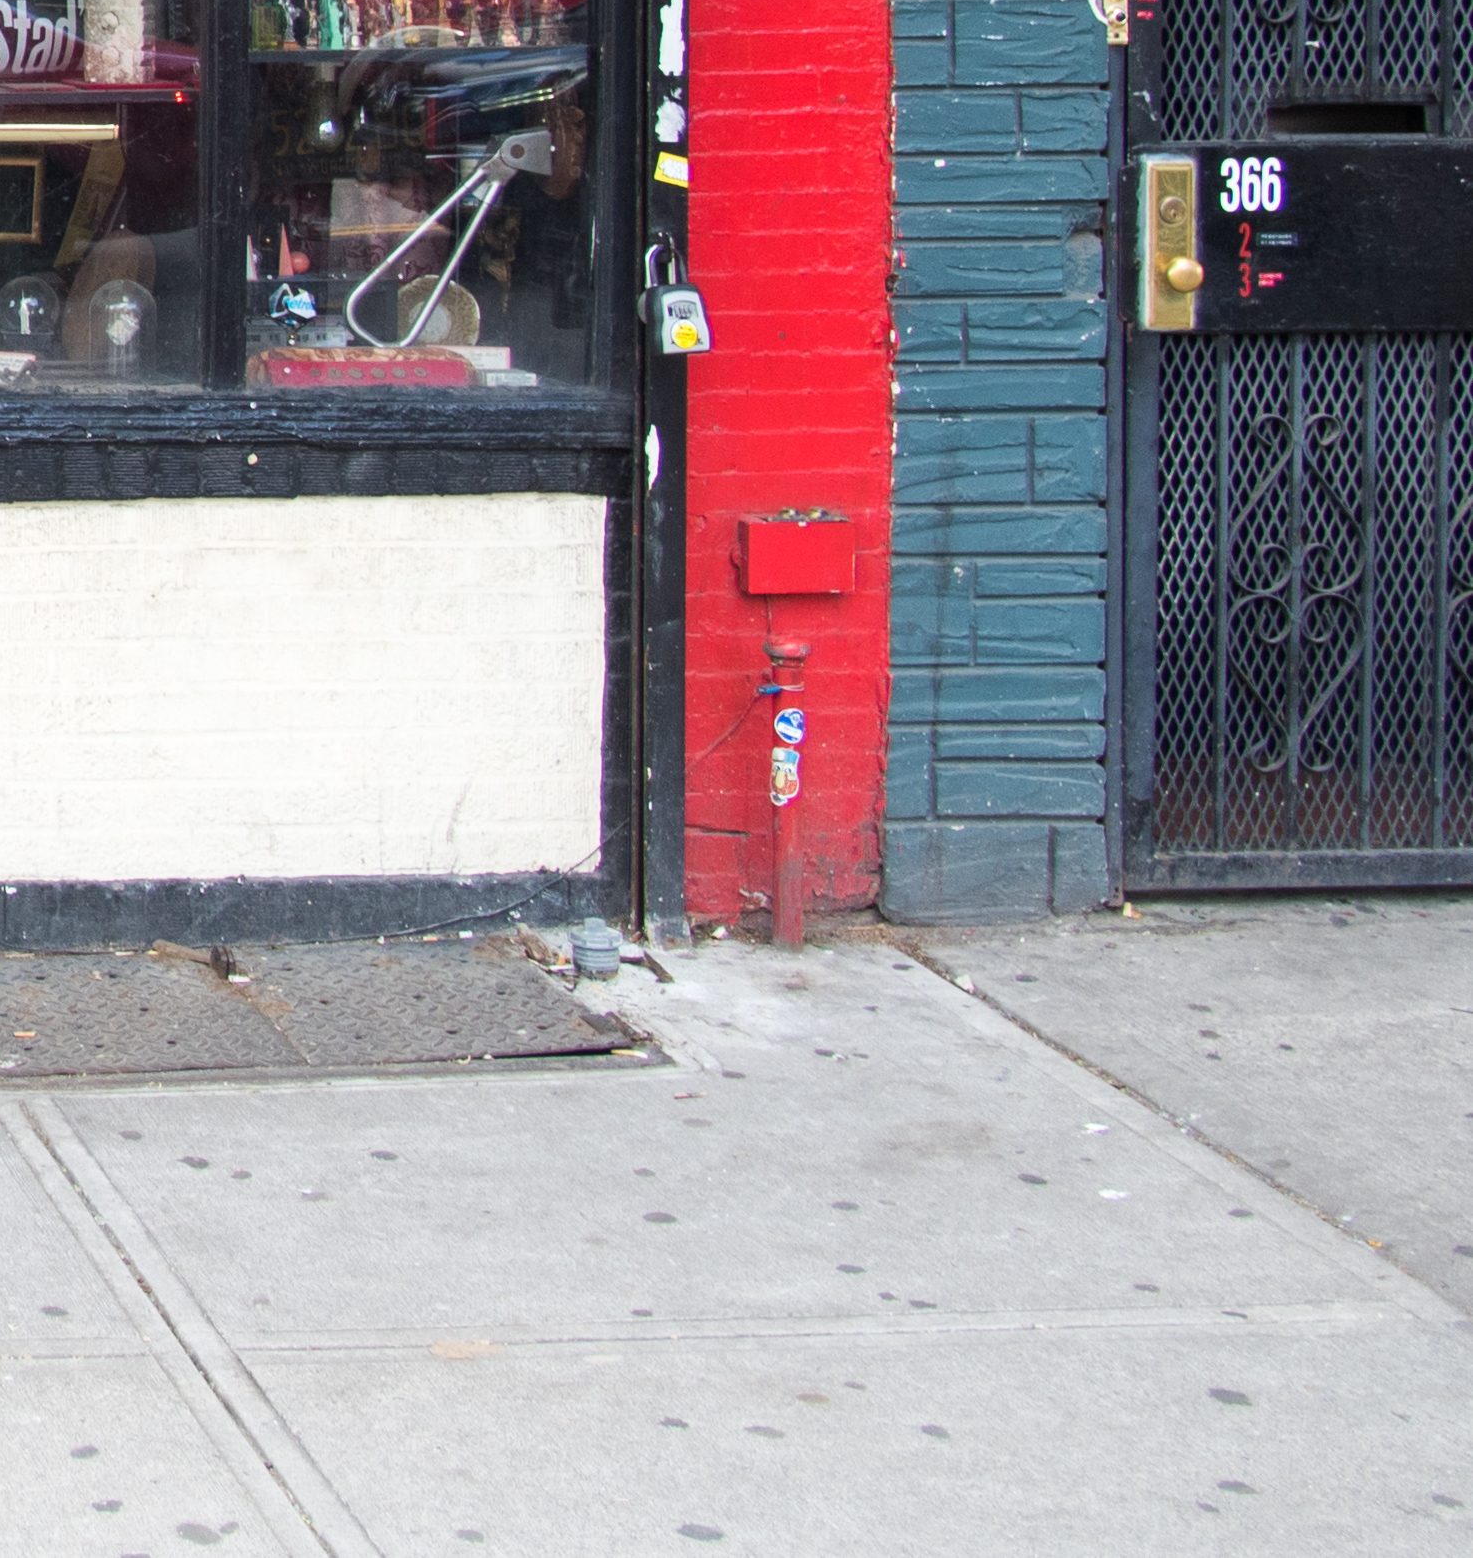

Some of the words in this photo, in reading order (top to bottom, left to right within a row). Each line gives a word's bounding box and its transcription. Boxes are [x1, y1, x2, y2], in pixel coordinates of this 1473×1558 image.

[1220, 156, 1283, 213] 366
[1239, 223, 1251, 258] 2
[1239, 263, 1251, 297] 3
